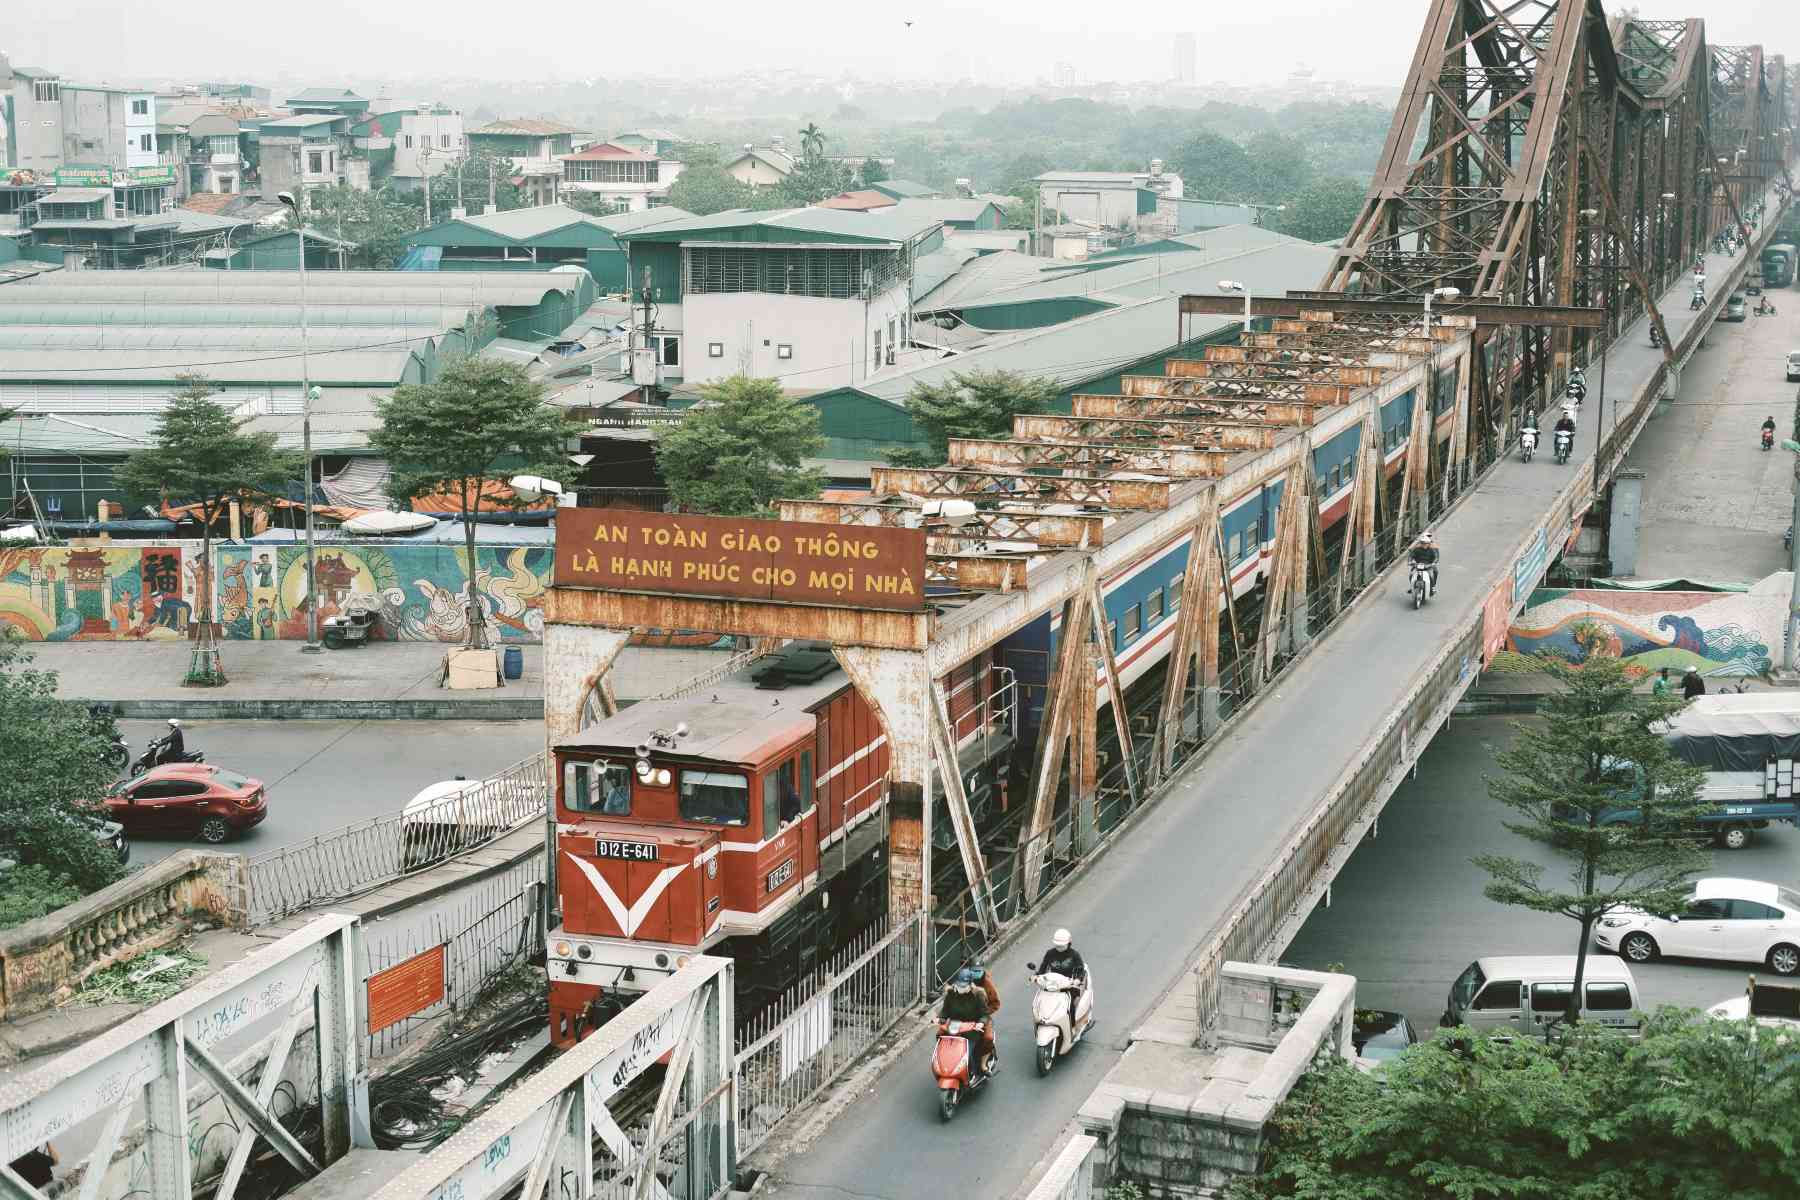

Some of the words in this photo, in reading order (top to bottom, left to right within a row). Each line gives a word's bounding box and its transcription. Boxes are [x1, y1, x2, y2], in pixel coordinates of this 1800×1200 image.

[594, 525, 628, 544] AN
[642, 523, 707, 549] TOÀN
[794, 532, 879, 559] THÔNG
[572, 548, 599, 573] LÀ
[611, 556, 672, 580] HẠNH
[683, 556, 740, 583] PHÚC
[751, 567, 797, 586] CHO
[865, 568, 915, 595] NHÀ
